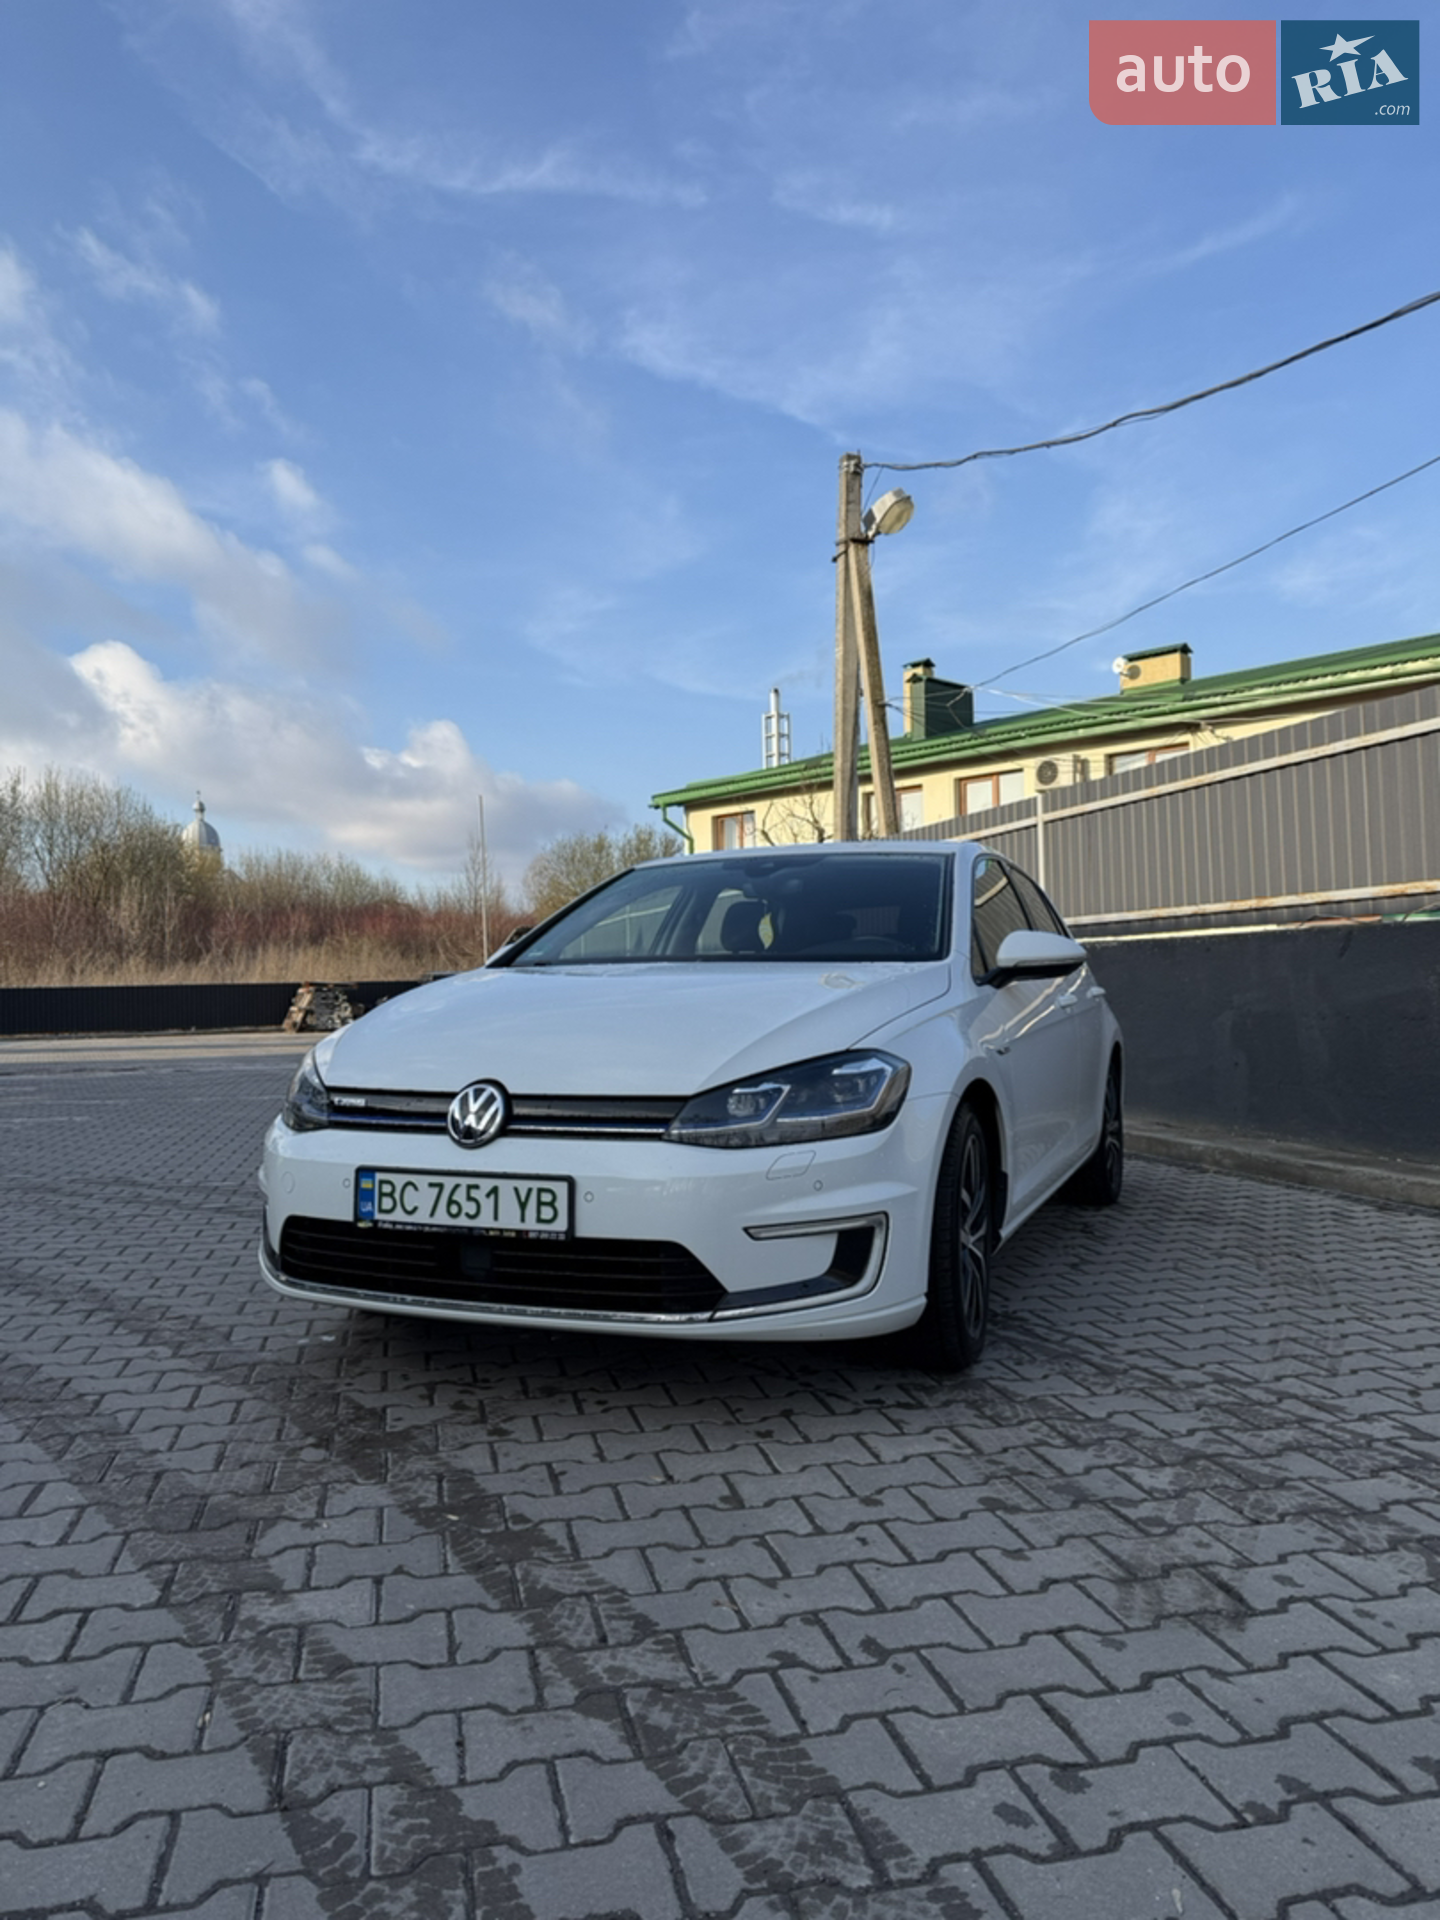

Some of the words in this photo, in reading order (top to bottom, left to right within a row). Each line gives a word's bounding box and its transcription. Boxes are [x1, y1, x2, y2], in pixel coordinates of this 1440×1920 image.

[377, 1179, 419, 1216] BC
[428, 1181, 499, 1222] 7651
[513, 1185, 559, 1224] YB
